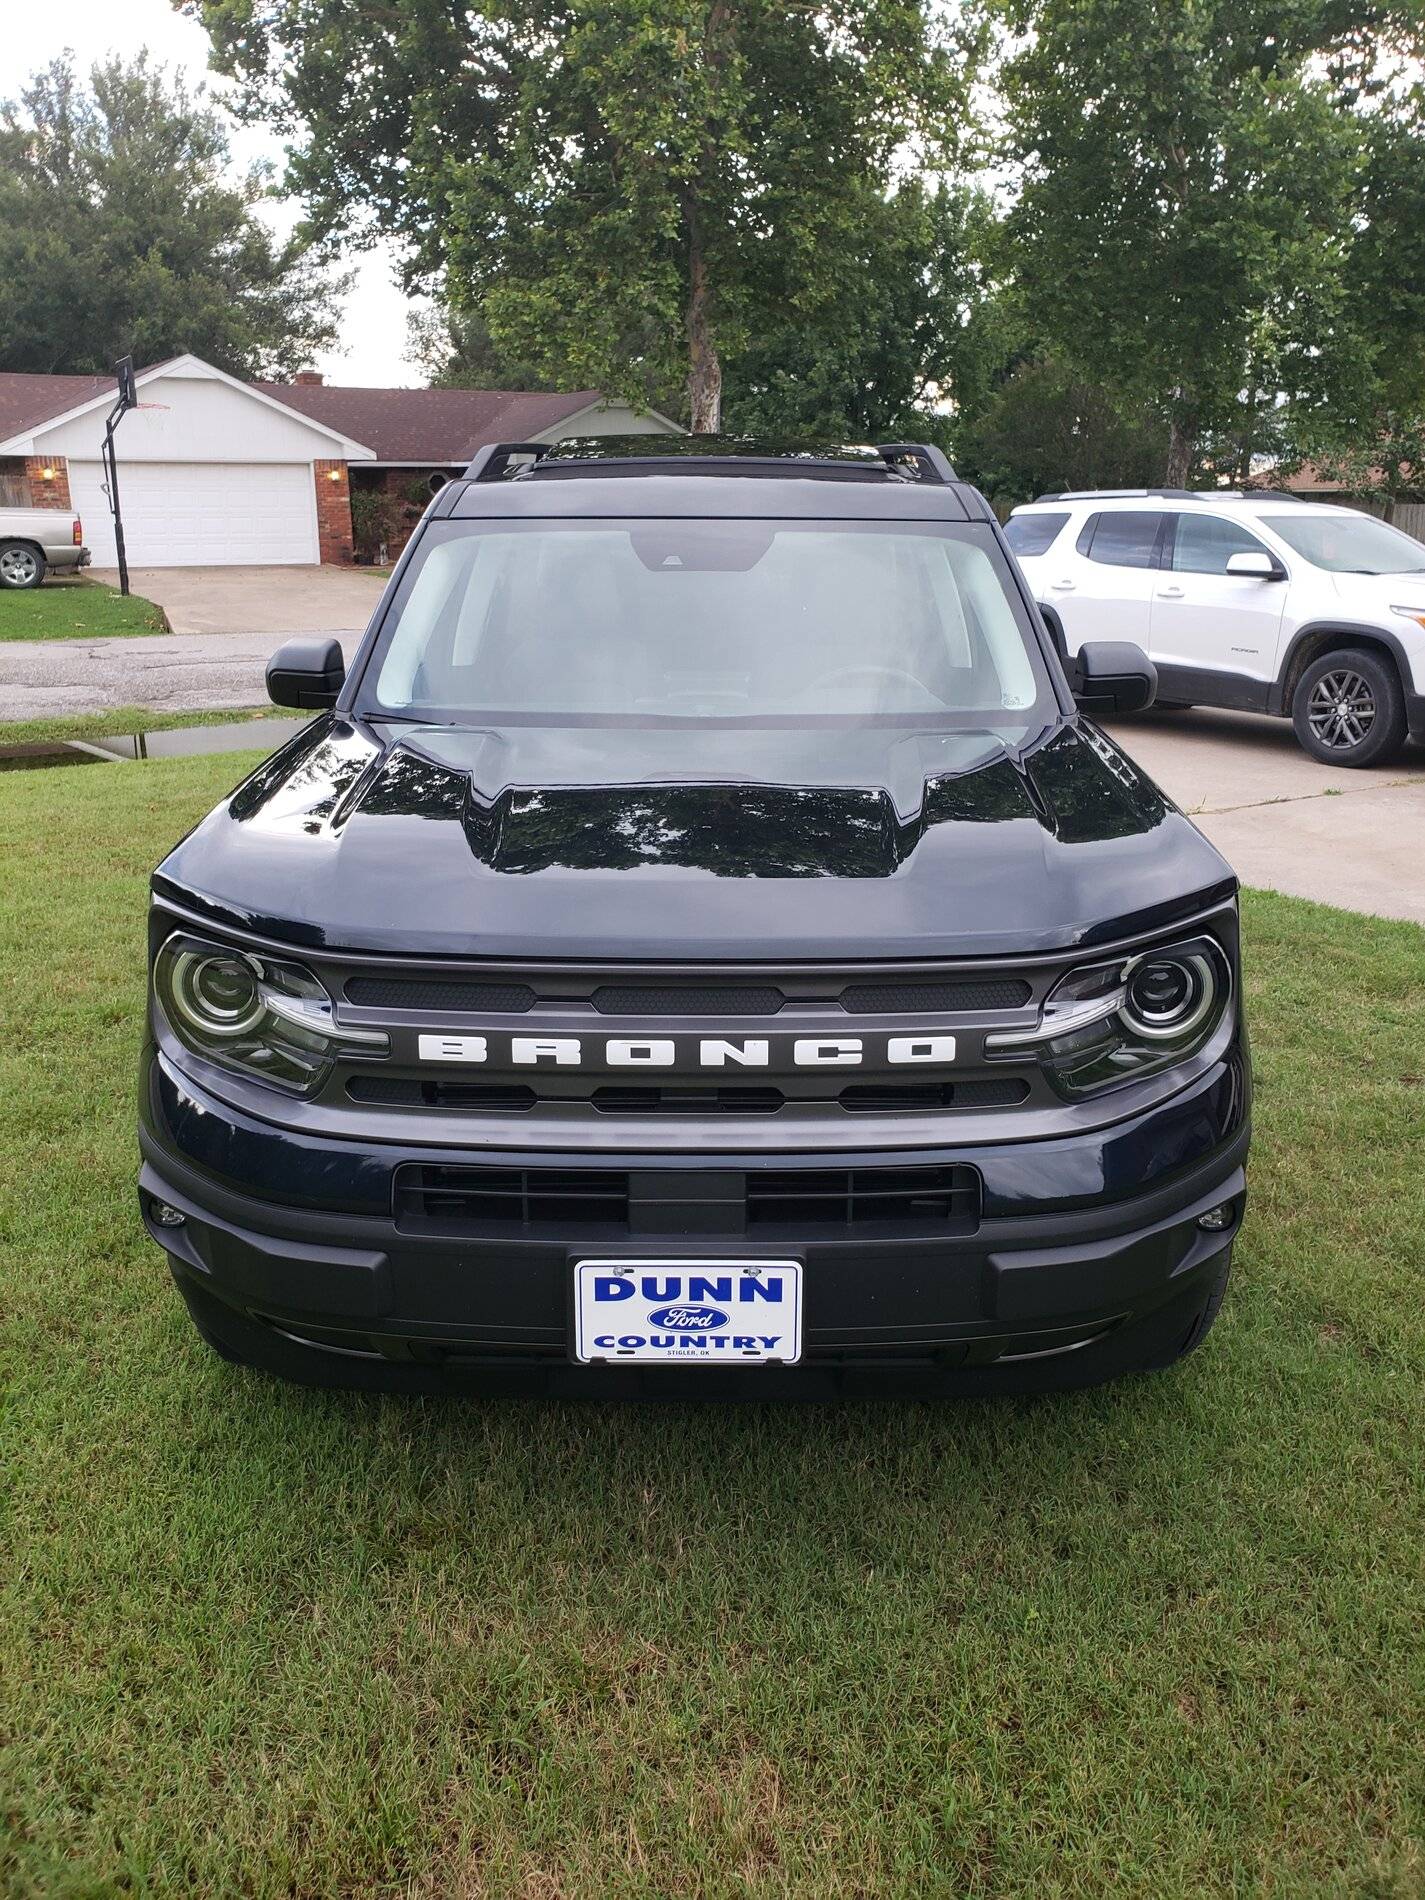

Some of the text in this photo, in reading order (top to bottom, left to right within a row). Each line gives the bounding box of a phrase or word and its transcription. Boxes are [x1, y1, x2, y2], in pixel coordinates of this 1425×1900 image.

[418, 1034, 956, 1066] BRONCO
[594, 1277, 783, 1302] DUNN
[663, 1306, 714, 1328] Ford
[593, 1335, 783, 1349] COUNTRY
